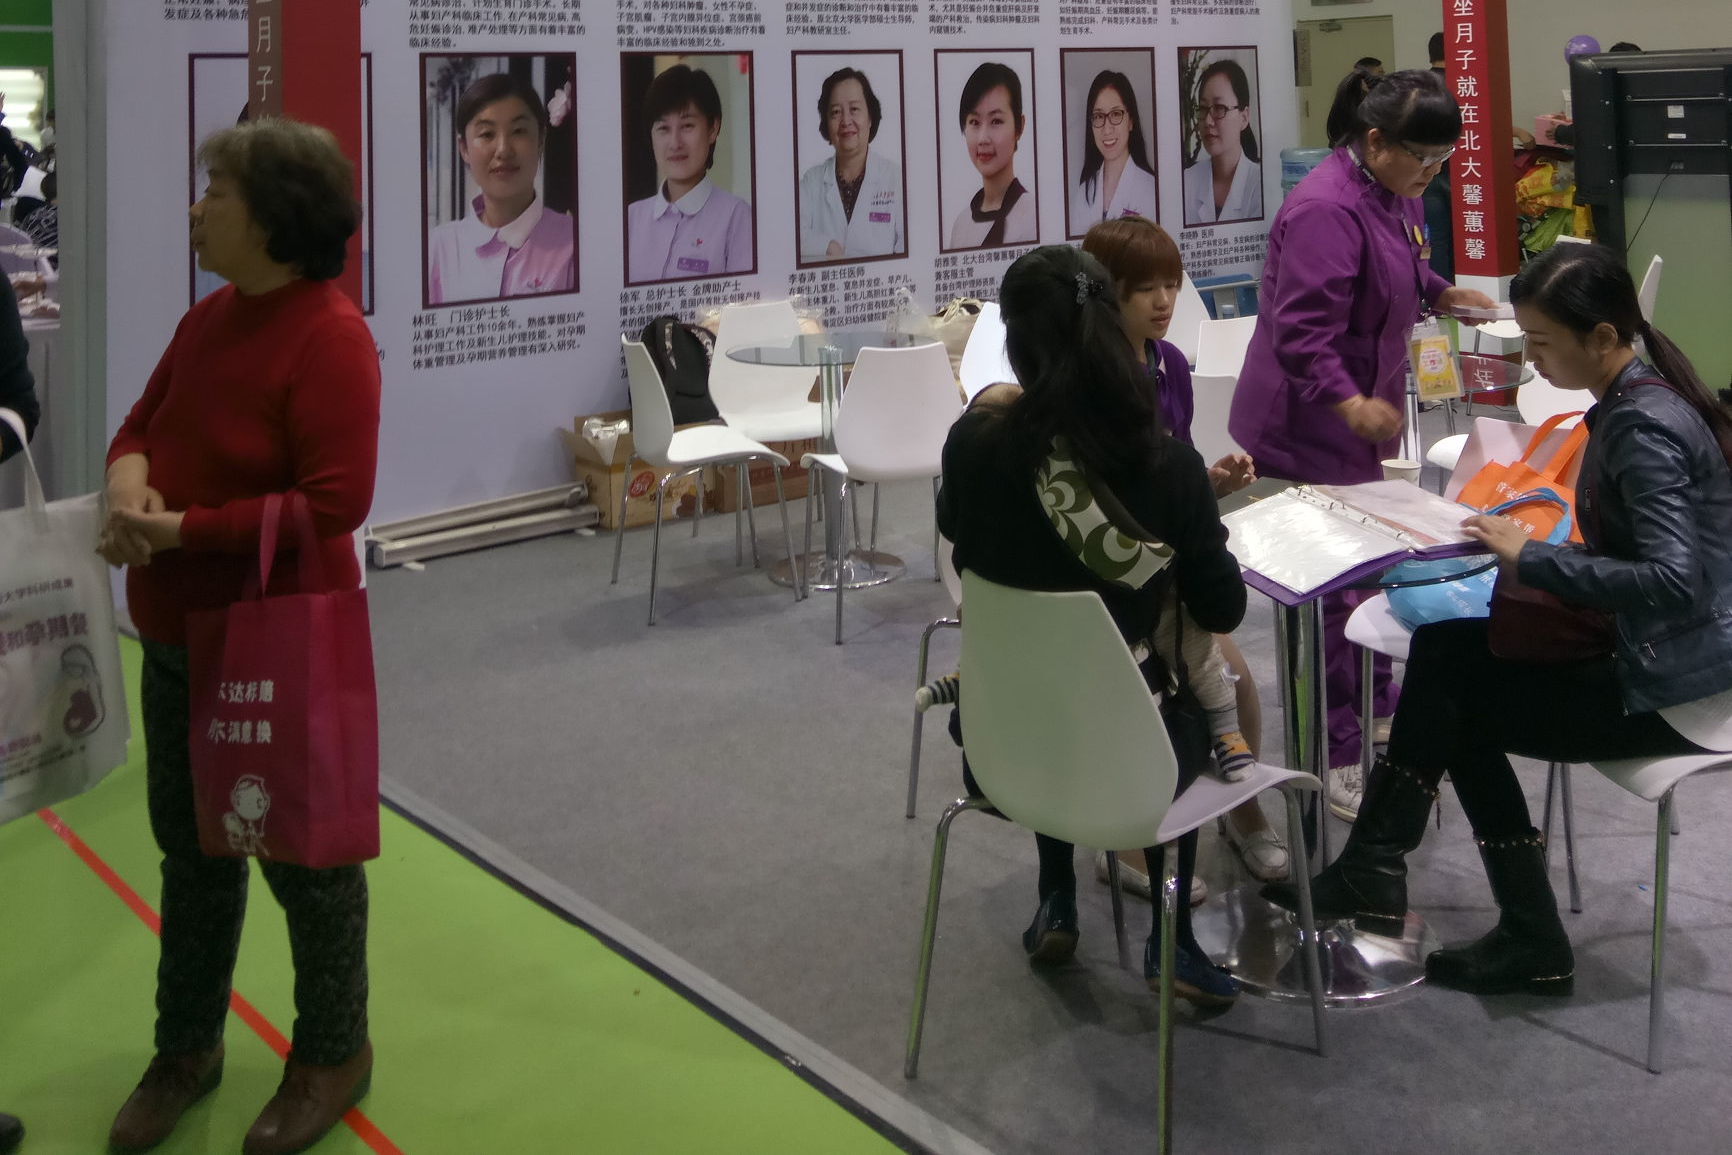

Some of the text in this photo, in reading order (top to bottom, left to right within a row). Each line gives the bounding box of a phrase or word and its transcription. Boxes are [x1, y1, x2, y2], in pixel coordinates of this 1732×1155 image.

[821, 266, 866, 281] 副主任医师
[450, 304, 511, 323] 门诊护士长
